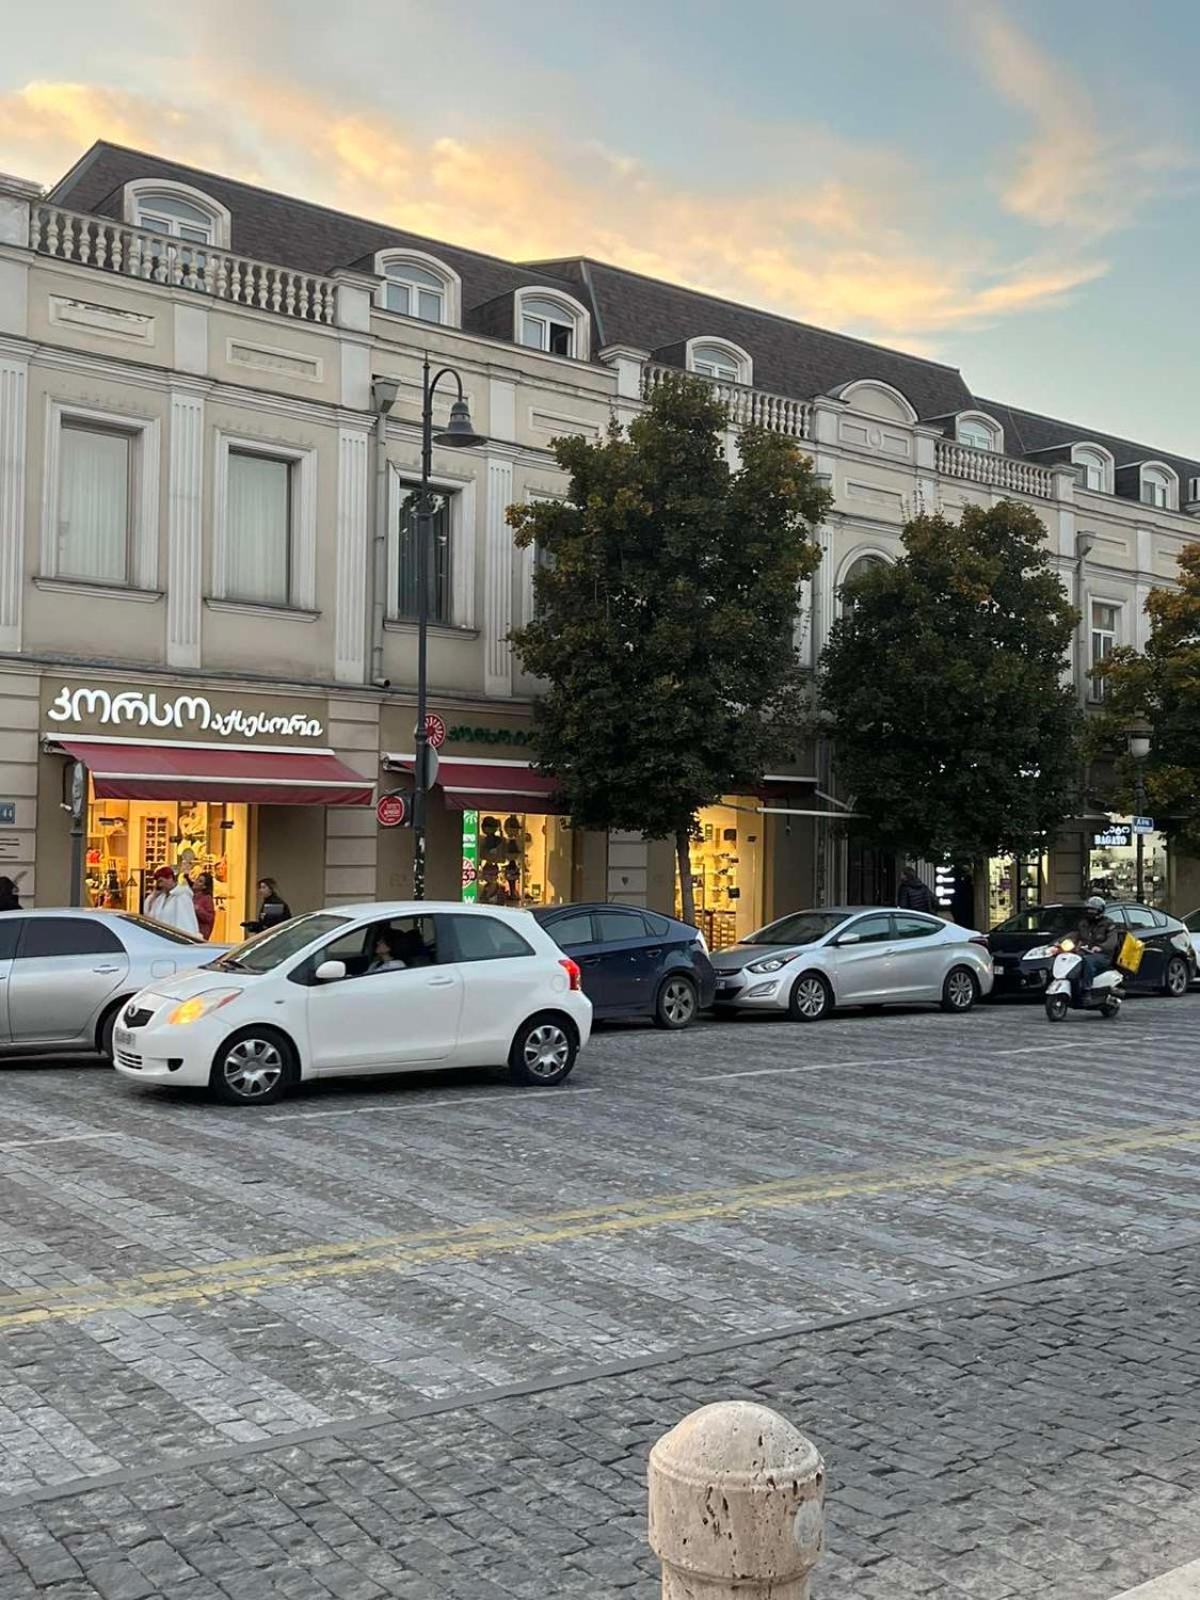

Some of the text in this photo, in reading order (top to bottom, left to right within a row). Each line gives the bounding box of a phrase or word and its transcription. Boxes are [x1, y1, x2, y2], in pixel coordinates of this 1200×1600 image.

[47, 687, 323, 737] კორსო აქსესორი
[1094, 835, 1127, 845] BAGATO
